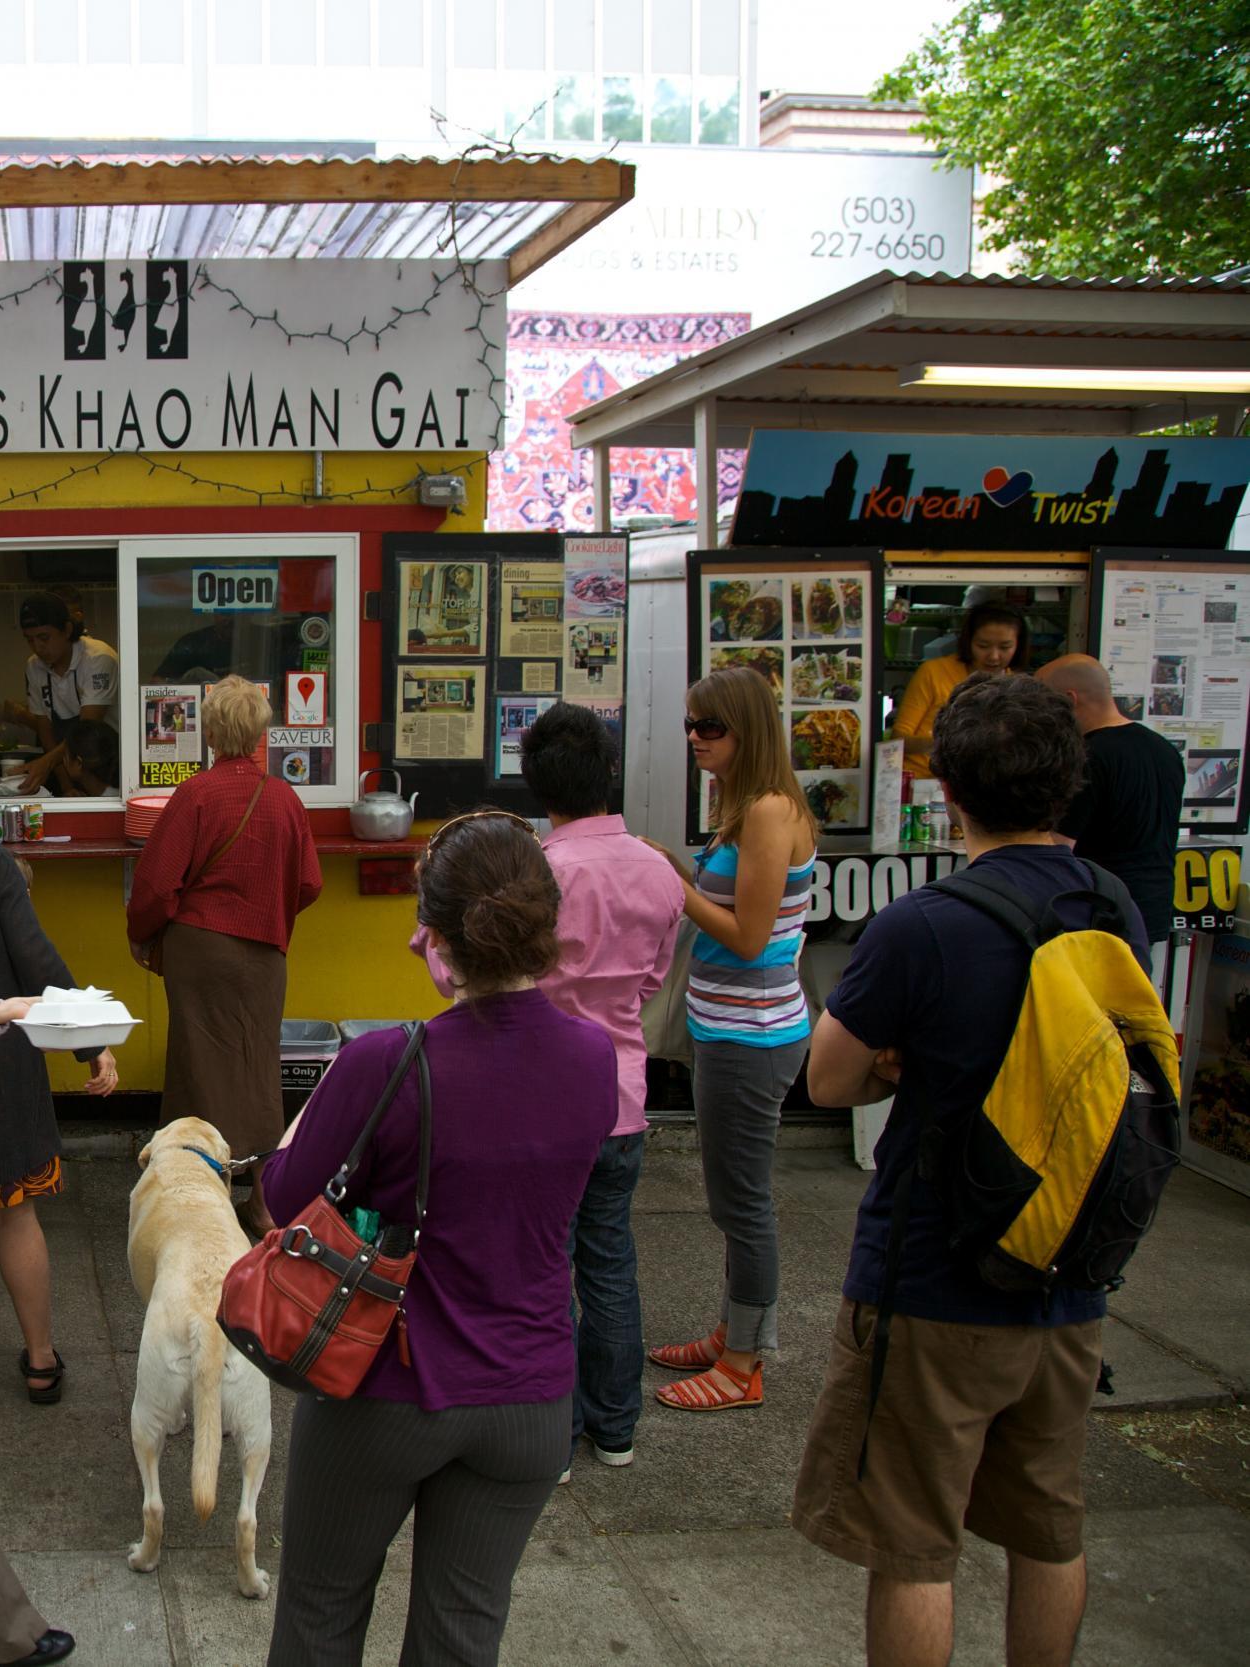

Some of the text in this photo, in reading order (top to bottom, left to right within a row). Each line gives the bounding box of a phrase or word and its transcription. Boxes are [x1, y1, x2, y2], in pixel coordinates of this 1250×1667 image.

[841, 196, 916, 231] (503)
[810, 230, 946, 261] 227-6650
[629, 250, 740, 272] & ESTATES
[39, 373, 192, 449] KHAO
[222, 370, 340, 448] MAN
[371, 370, 471, 449] GAI
[864, 485, 1120, 525] Korean Twist
[504, 568, 530, 580] dining
[197, 572, 273, 607] Open
[145, 686, 178, 697] insider
[292, 713, 319, 723] Google
[270, 731, 332, 745] SAVEUR
[142, 762, 201, 774] TRAVEL+
[293, 1067, 317, 1077] Only
